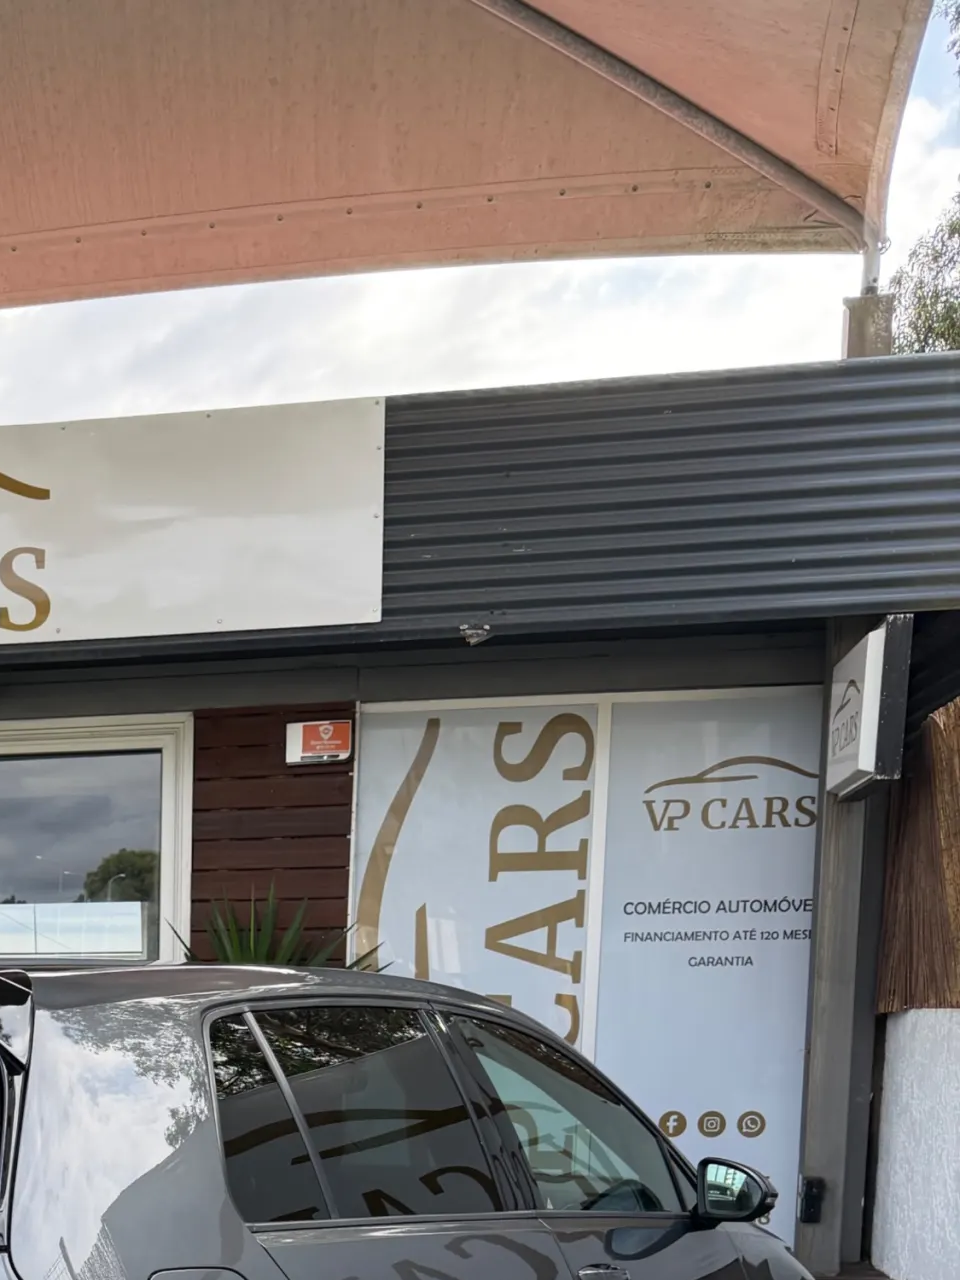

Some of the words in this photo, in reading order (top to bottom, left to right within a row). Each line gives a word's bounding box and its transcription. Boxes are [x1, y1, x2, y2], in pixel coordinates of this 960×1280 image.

[642, 799, 691, 831] VP
[701, 796, 817, 829] CARS
[623, 898, 711, 915] COMÉRCIO
[715, 896, 813, 914] AUTOMÓVE
[624, 930, 730, 942] FINANCIAMENTO
[733, 928, 757, 941] ATÉ
[760, 930, 779, 941] 120
[688, 956, 754, 967] GARANTIA
